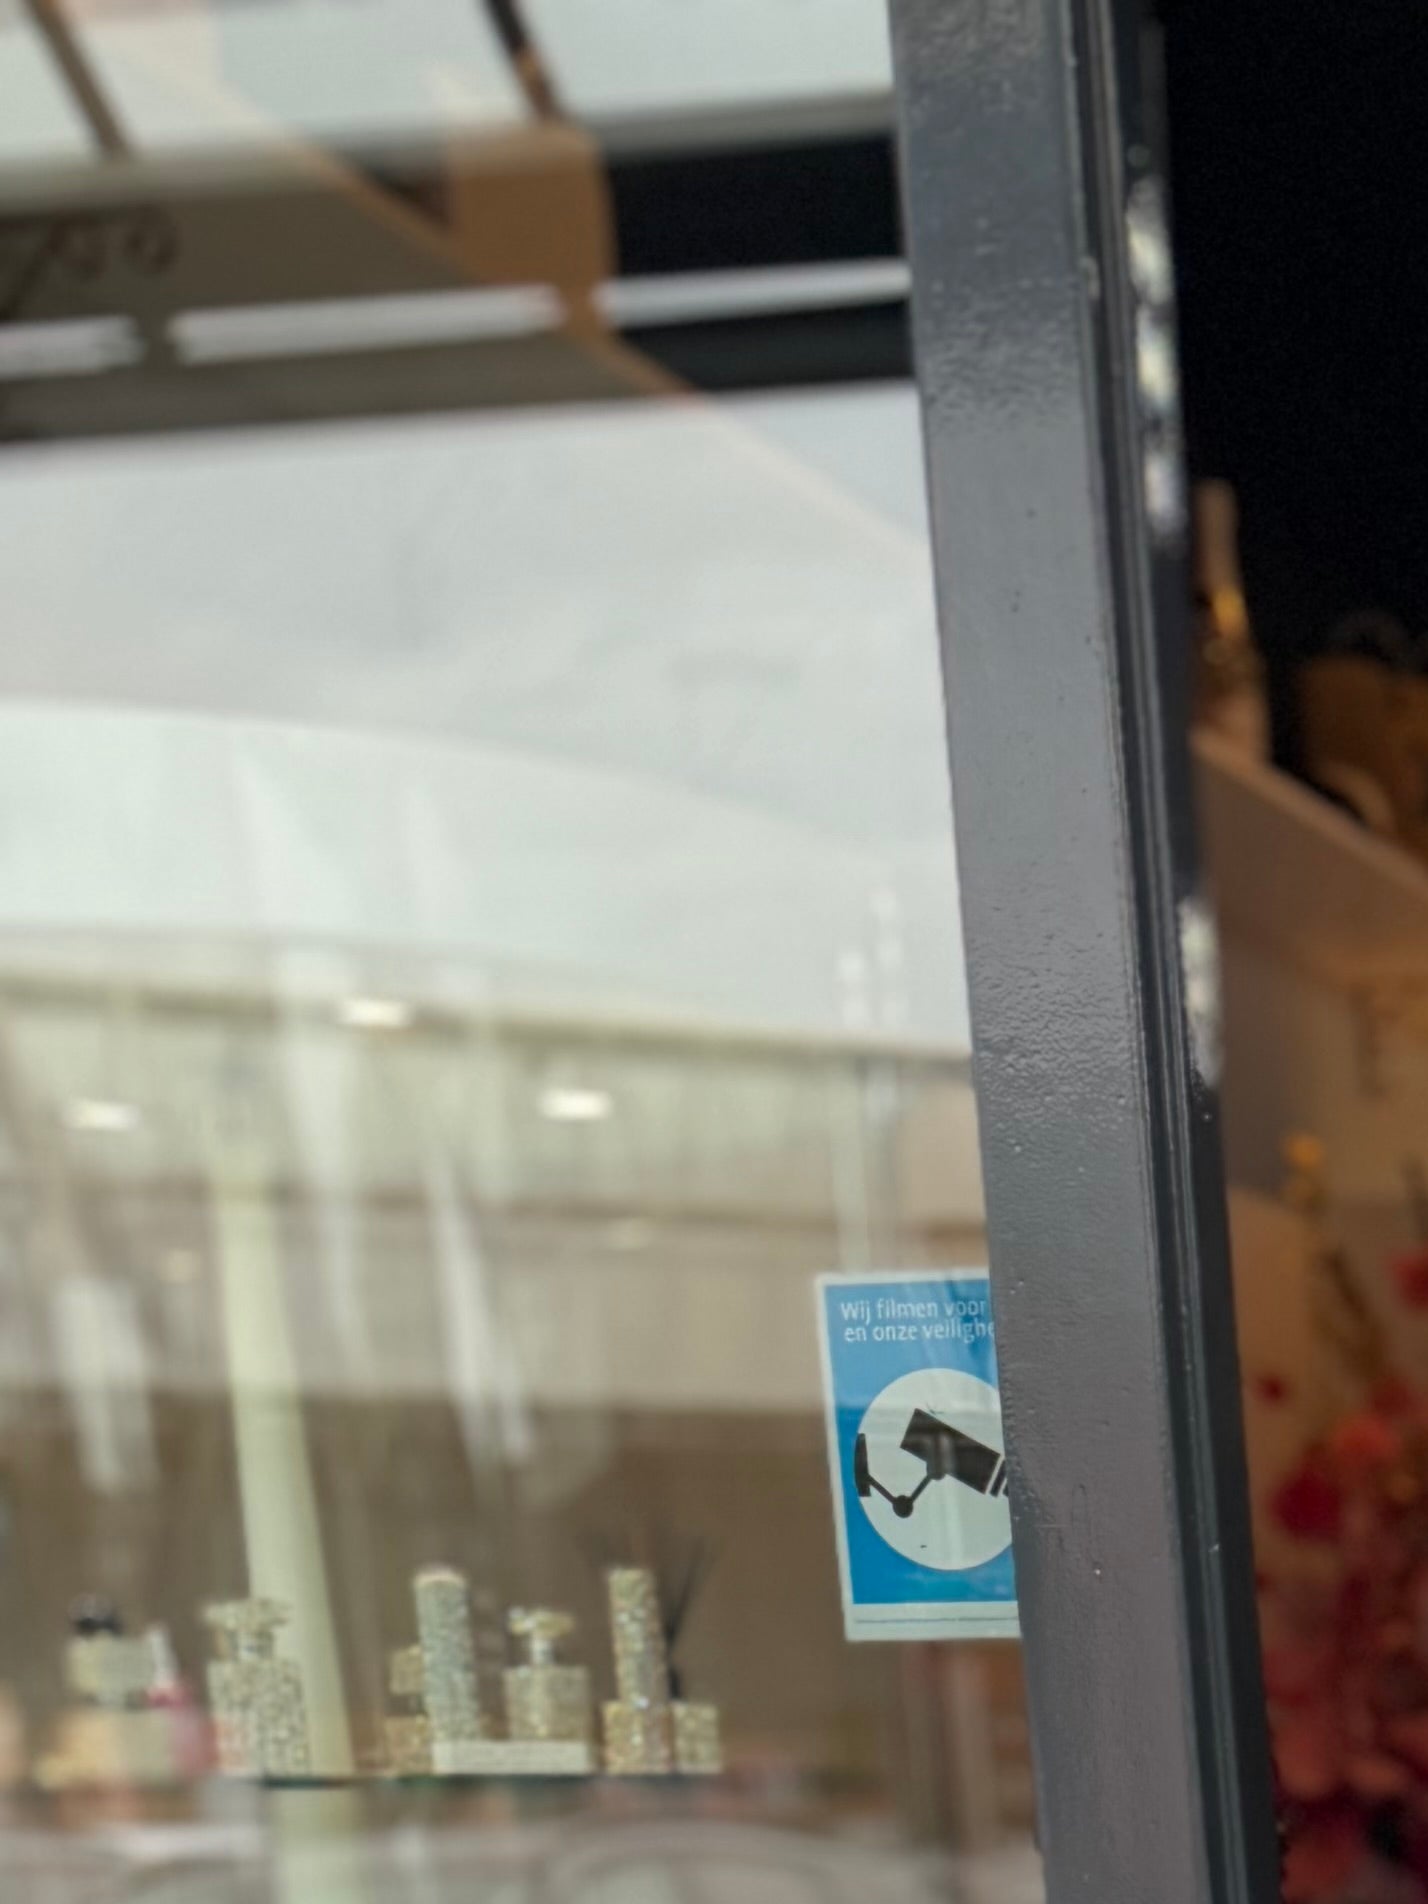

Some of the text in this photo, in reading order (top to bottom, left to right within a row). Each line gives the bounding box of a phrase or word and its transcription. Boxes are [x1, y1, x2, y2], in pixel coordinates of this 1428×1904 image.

[840, 1298, 986, 1325] Wij filmen voor
[844, 1325, 867, 1342] en
[872, 1324, 918, 1341] onze
